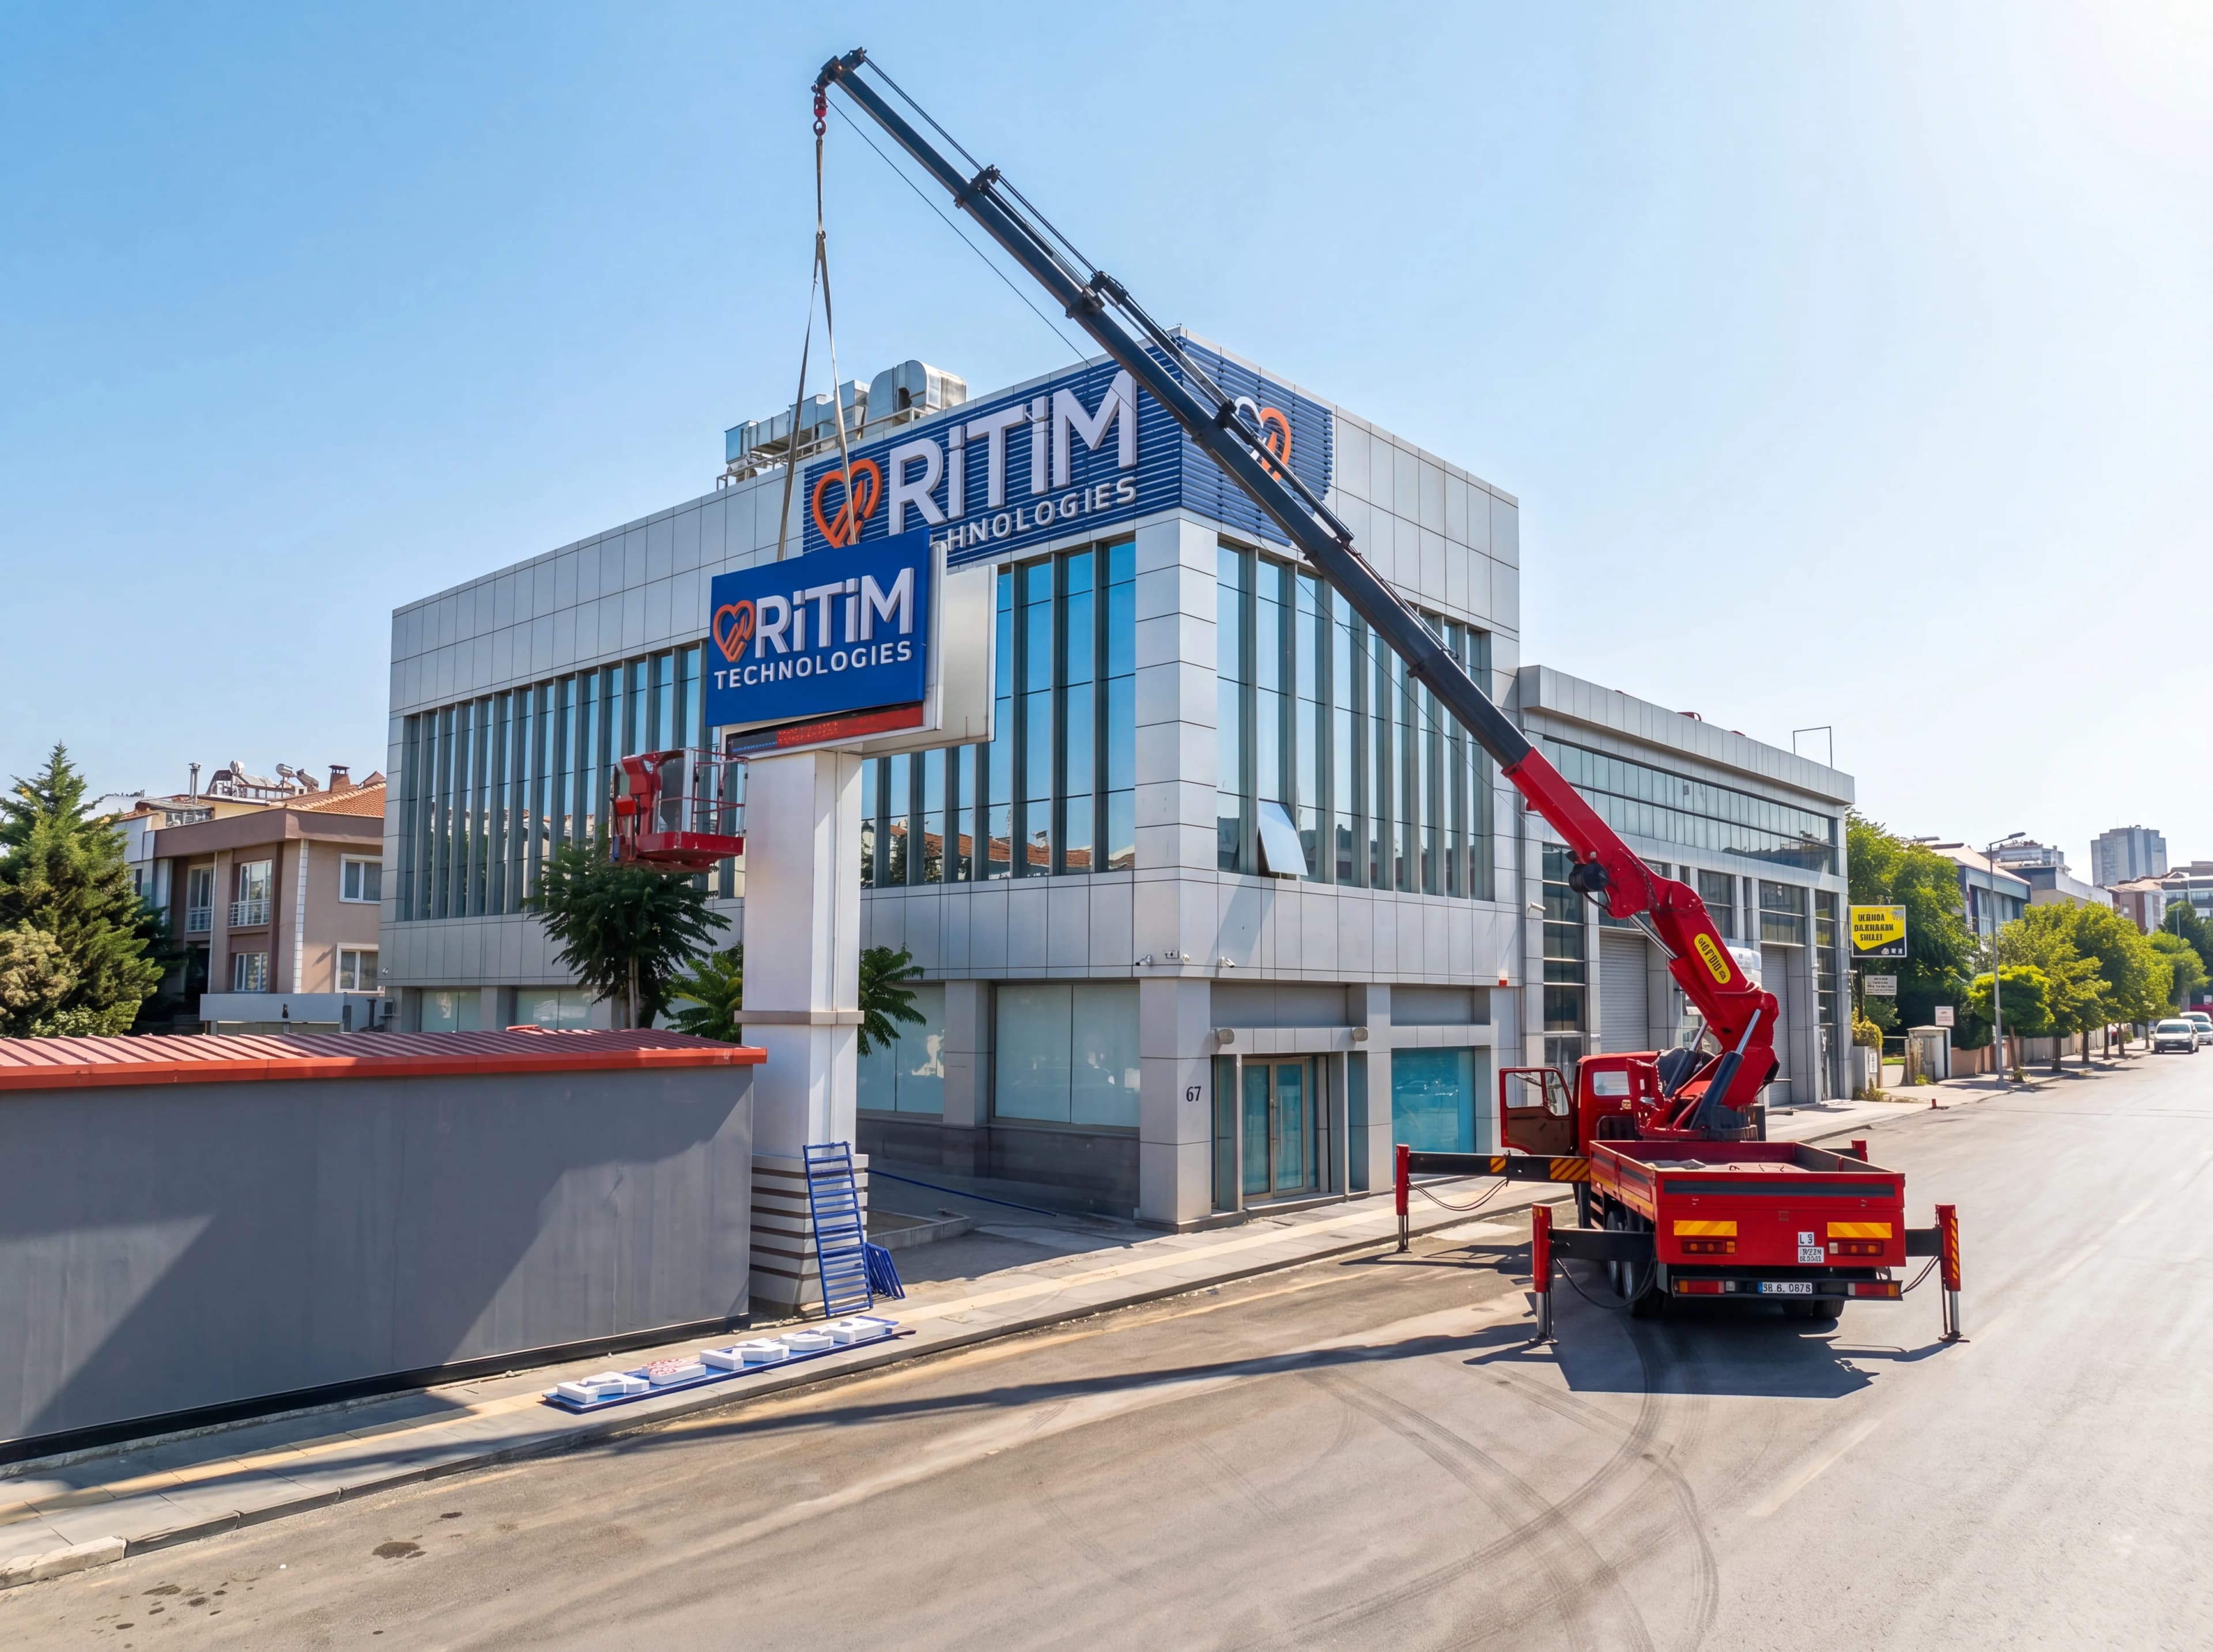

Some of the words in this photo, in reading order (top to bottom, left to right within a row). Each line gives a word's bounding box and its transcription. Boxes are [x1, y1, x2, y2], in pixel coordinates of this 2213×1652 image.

[930, 476, 1136, 551] HNOLOGIES
[714, 641, 912, 690] TECHNOLOGIES
[1186, 1086, 1202, 1102] 67
